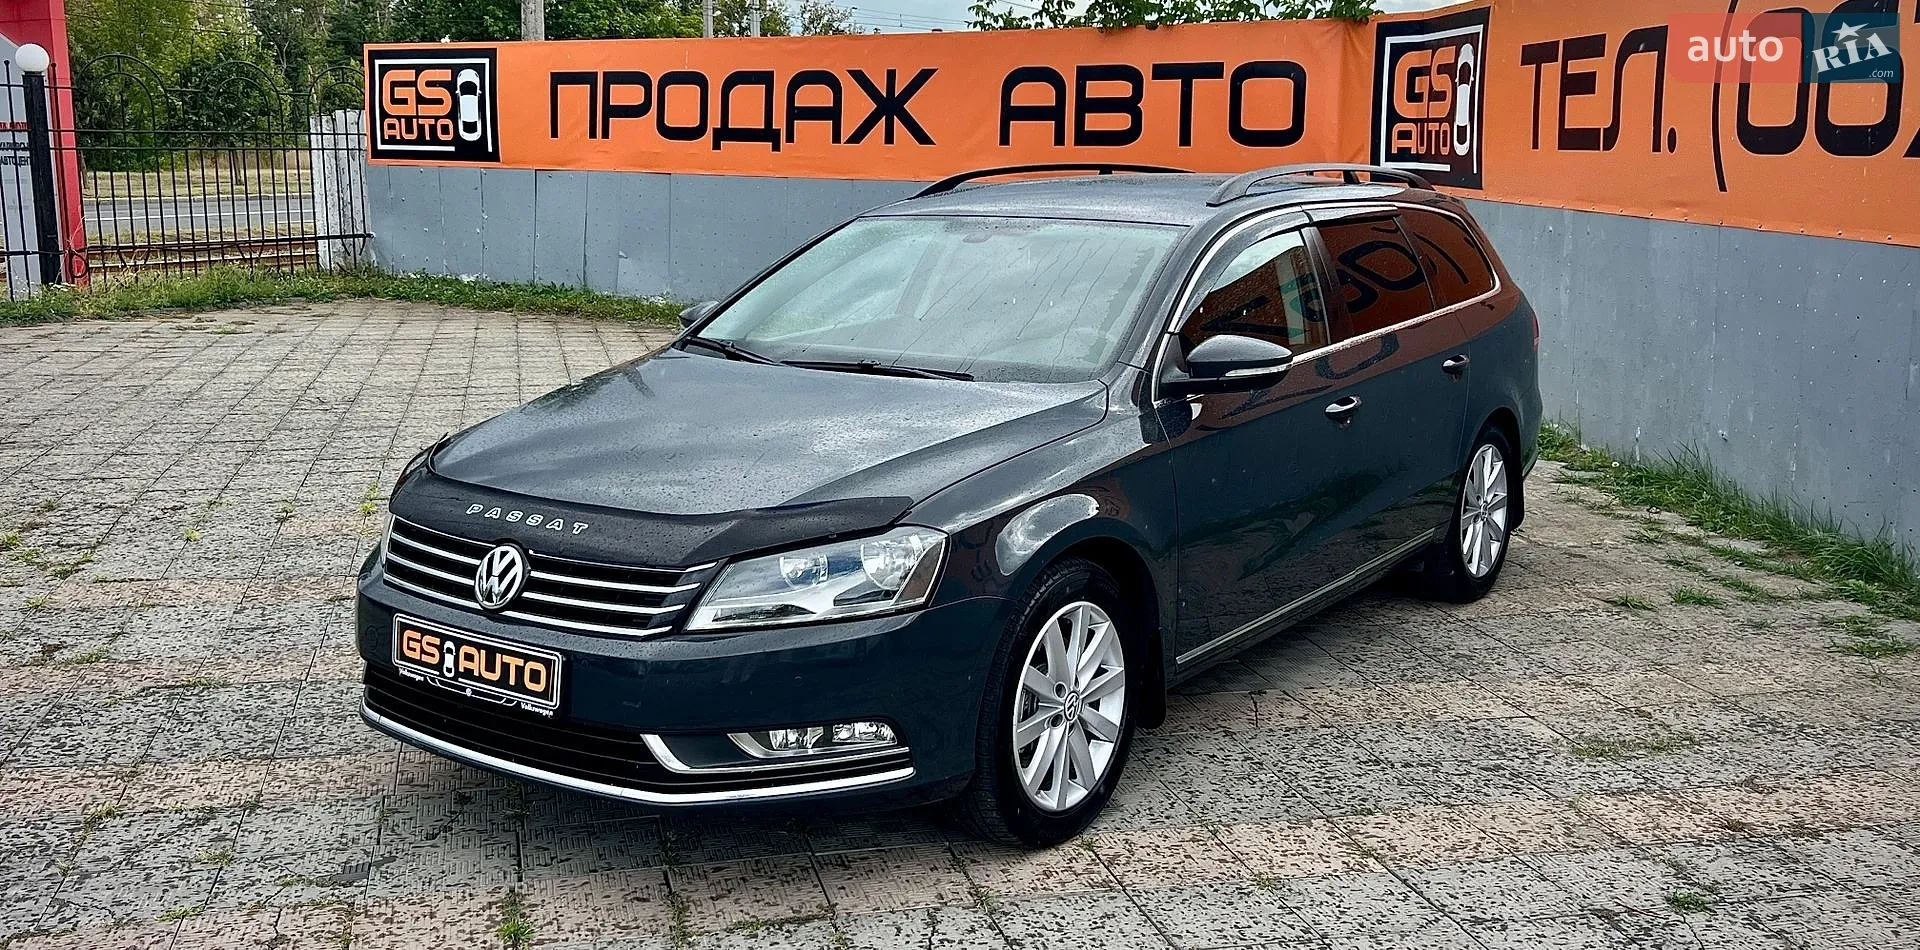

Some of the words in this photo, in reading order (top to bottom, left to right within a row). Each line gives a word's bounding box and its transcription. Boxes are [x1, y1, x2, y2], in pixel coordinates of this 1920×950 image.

[383, 69, 452, 116] GS
[549, 67, 939, 152] ПРОДАЖ
[998, 60, 1308, 148] АВТО
[1394, 46, 1456, 118] GS
[1520, 25, 1677, 154] ТЕЛ.
[1711, 0, 1920, 193] (06
[383, 118, 453, 140] AUTO
[1391, 122, 1450, 155] AUTO
[466, 503, 588, 535] PASSAT
[402, 629, 441, 665] GS
[458, 645, 547, 692] AUTO
